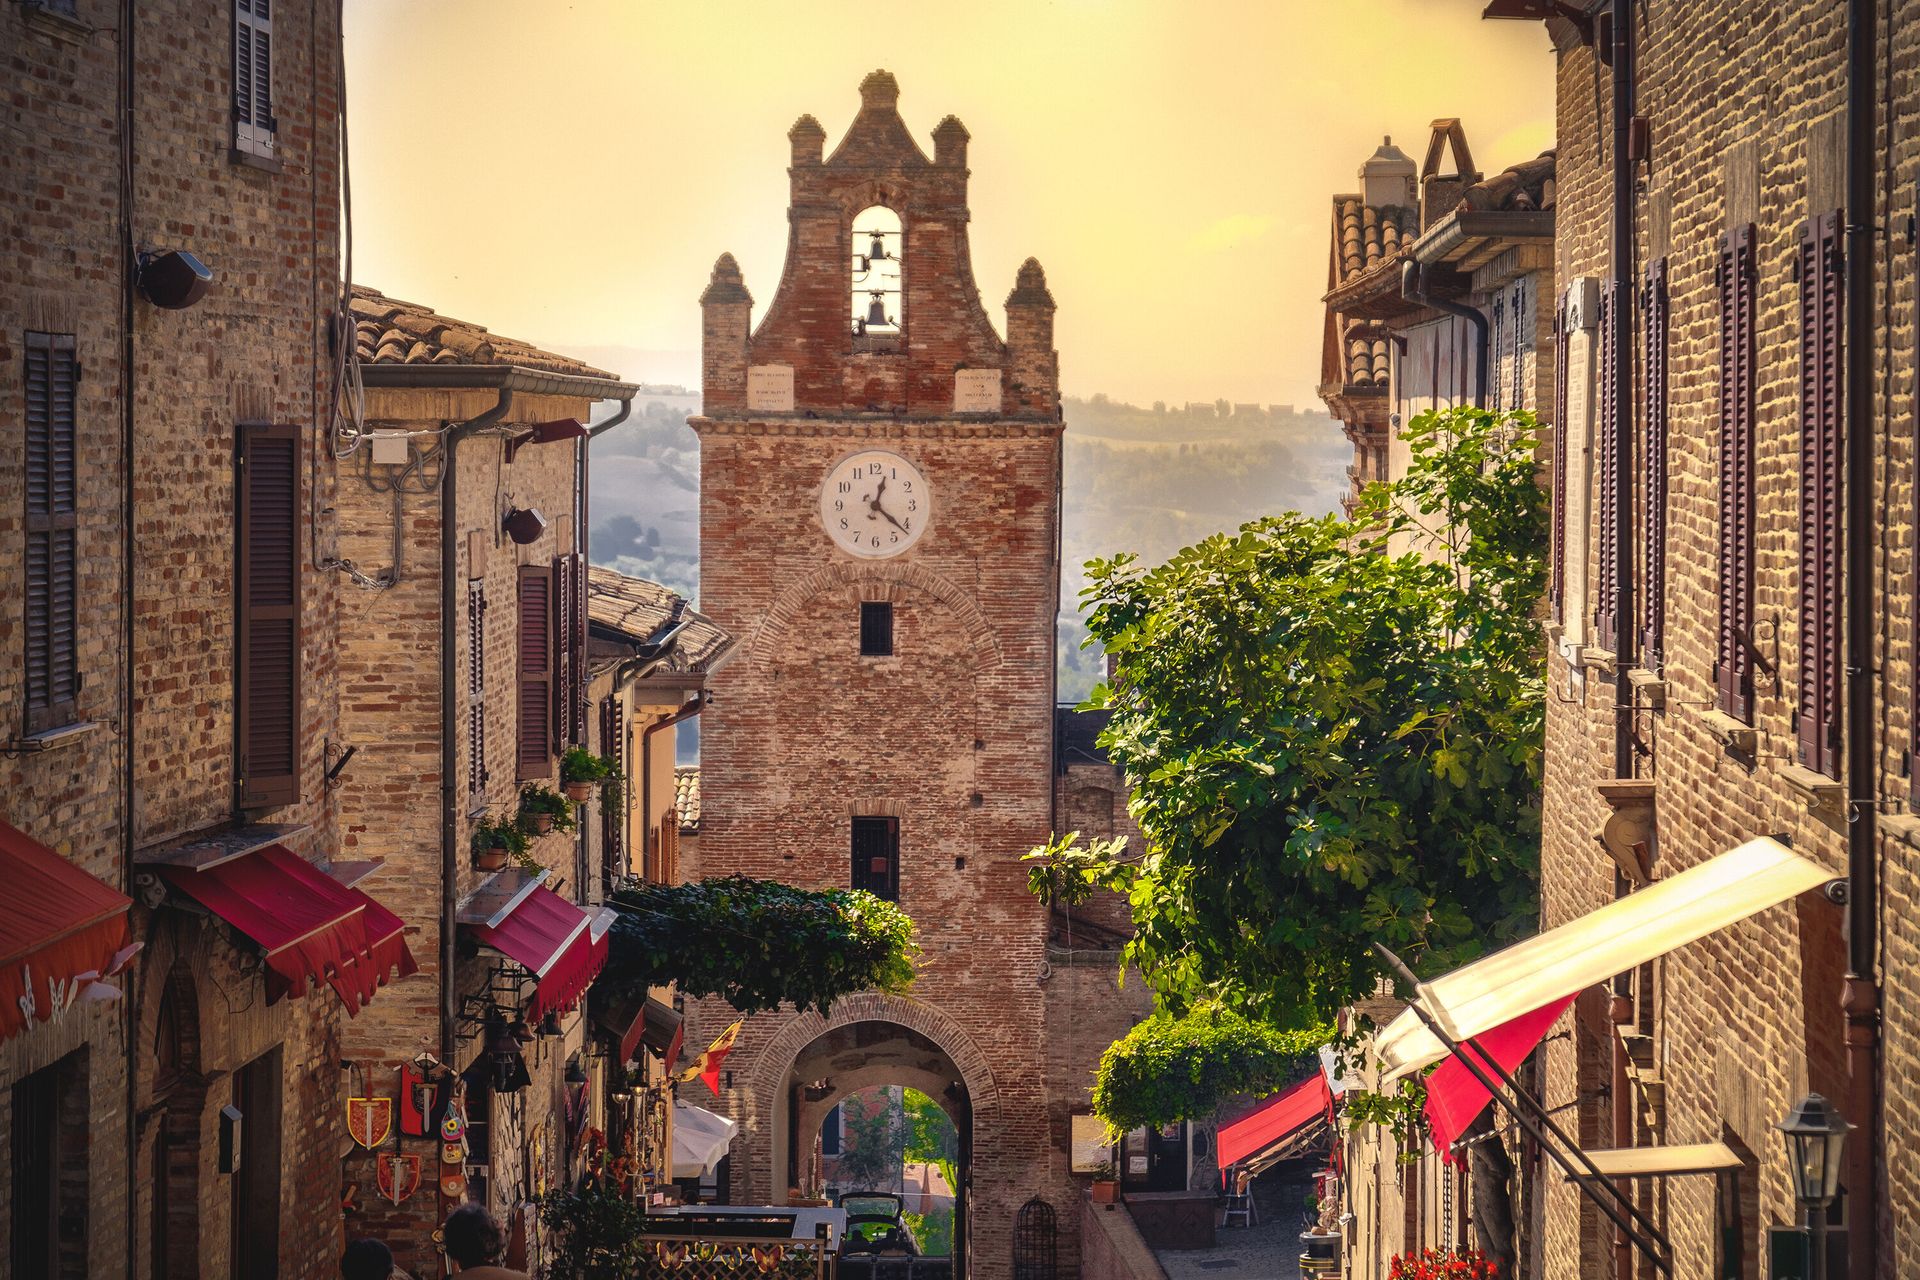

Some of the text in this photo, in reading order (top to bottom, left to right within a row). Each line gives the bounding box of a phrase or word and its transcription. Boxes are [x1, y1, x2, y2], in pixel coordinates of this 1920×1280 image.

[853, 468, 862, 479] 11
[869, 463, 882, 475] 12
[892, 468, 896, 479] 1
[839, 481, 851, 493] 10
[904, 481, 912, 493] 2
[835, 500, 843, 511] 9
[908, 500, 916, 511] 3
[840, 518, 848, 530] 8
[903, 517, 911, 529] 4
[853, 531, 861, 543] 7
[871, 536, 880, 548] 6
[890, 531, 898, 543] 5
